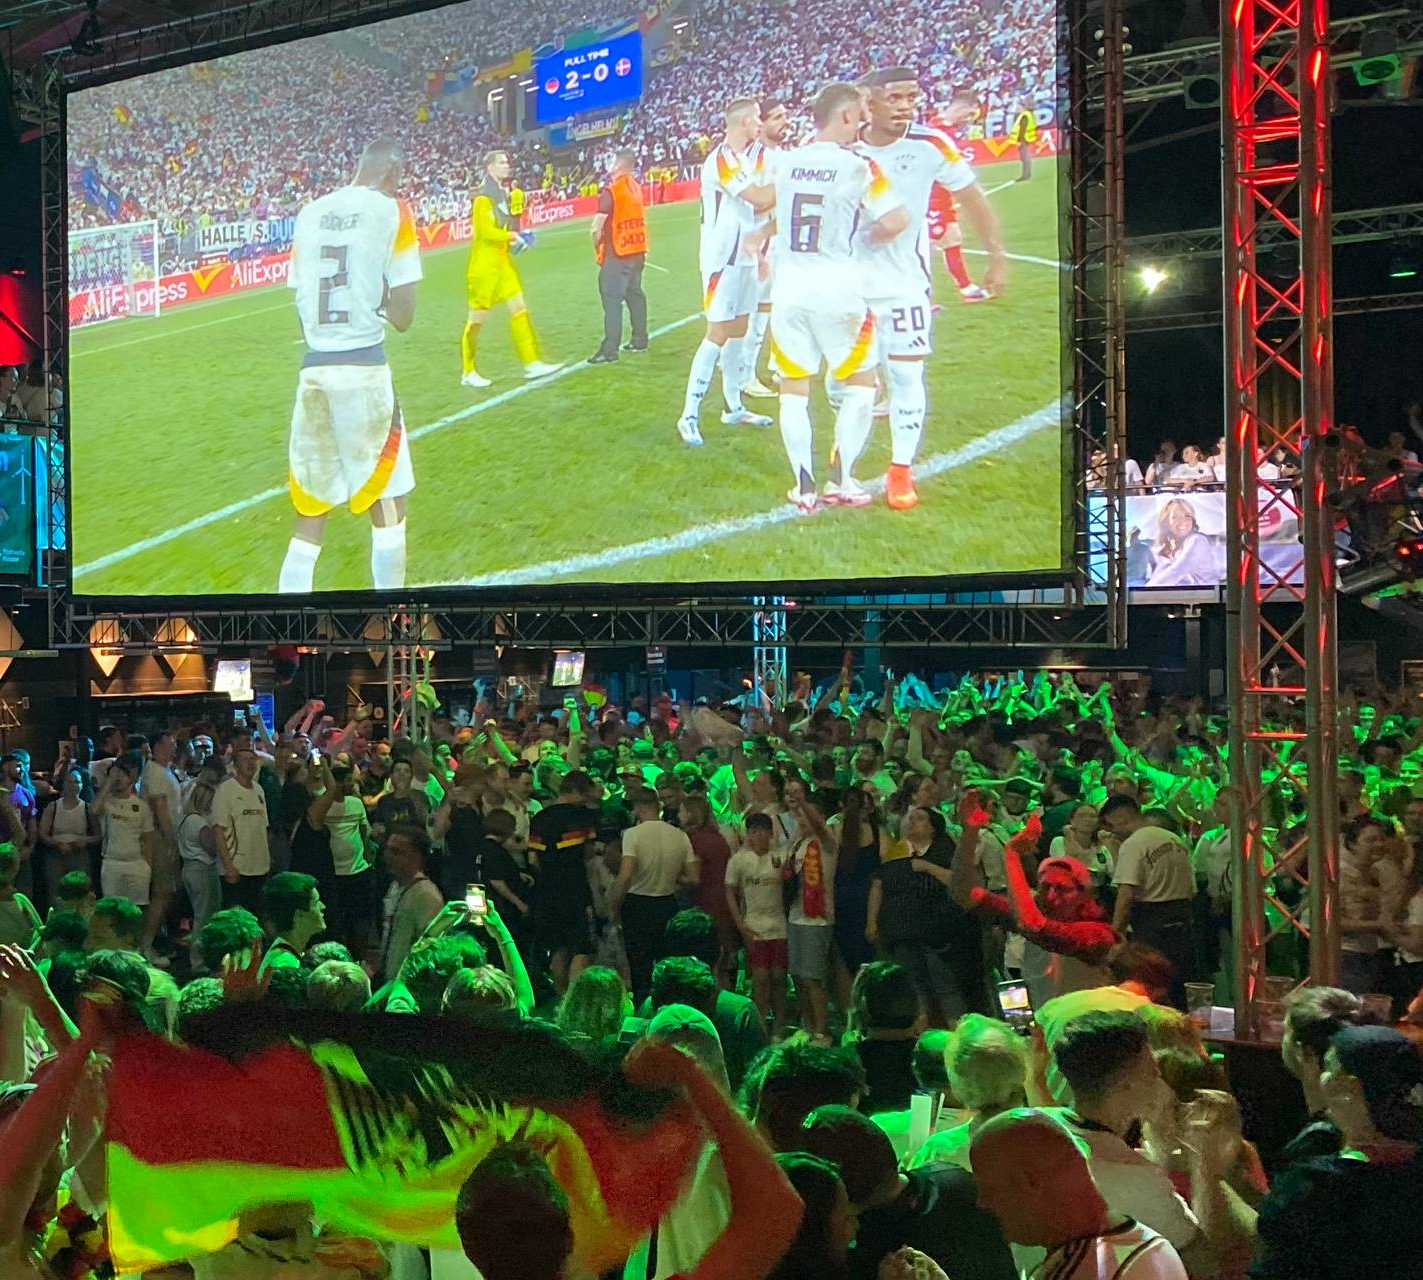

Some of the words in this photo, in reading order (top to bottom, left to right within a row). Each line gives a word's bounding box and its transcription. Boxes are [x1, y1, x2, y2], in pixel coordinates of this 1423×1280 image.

[564, 54, 587, 68] FULL
[587, 48, 610, 62] TIME
[790, 167, 838, 183] KIMMICH
[790, 192, 824, 253] 6
[201, 224, 245, 247] HALLE
[318, 244, 349, 324] 2
[891, 305, 925, 332] 20
